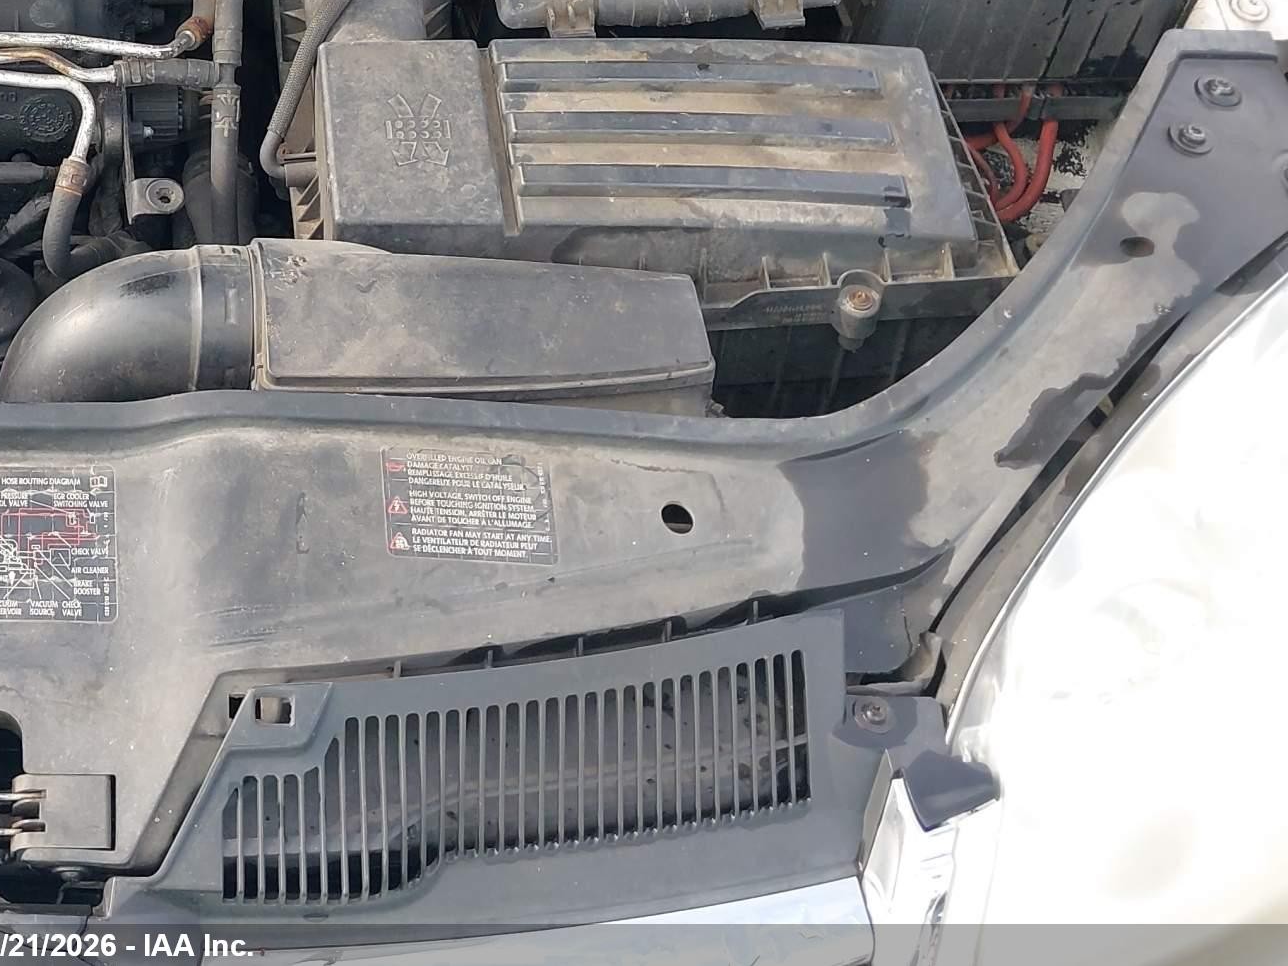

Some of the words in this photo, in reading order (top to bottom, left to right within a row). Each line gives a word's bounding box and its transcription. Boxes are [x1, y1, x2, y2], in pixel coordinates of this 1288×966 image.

[448, 455, 474, 463] ENGINE
[488, 457, 502, 465] CAN
[408, 461, 439, 469] DAMAGE
[440, 463, 473, 471] CATALYST
[408, 469, 455, 477] REMPLISSAGE
[1, 477, 18, 485] HOSE
[19, 477, 49, 485] ROUTING
[49, 477, 81, 485] DIAGRAM
[409, 477, 451, 486] DANGEREUX
[472, 480, 481, 488] LE
[409, 490, 428, 498] HIGH
[464, 493, 491, 501] SWITCH
[492, 494, 505, 502] OFF
[506, 496, 531, 504] ENGINE
[54, 500, 88, 508] SWITCHING
[410, 498, 436, 506] BEFORE
[437, 499, 473, 508] TOUCHING
[410, 505, 435, 514] HAUTE
[498, 511, 507, 519] LE
[508, 512, 537, 520] MOTEUR
[411, 514, 435, 522] AVANT
[448, 517, 479, 525] TOUCHER
[412, 527, 448, 536] RADIATOR
[449, 529, 463, 537] FAN
[516, 533, 531, 541] ANY
[412, 536, 421, 544] LE
[421, 536, 469, 546] VENTILATEUR
[480, 540, 520, 548] RADIATEUR
[520, 542, 538, 550] PEUT
[71, 547, 90, 555] CHECK
[413, 544, 421, 552] SE
[473, 547, 492, 556] TOUT
[71, 566, 82, 574] AIR
[83, 566, 109, 574] CLEANER
[30, 608, 55, 616] SOURCE
[62, 609, 82, 617] VALVE
